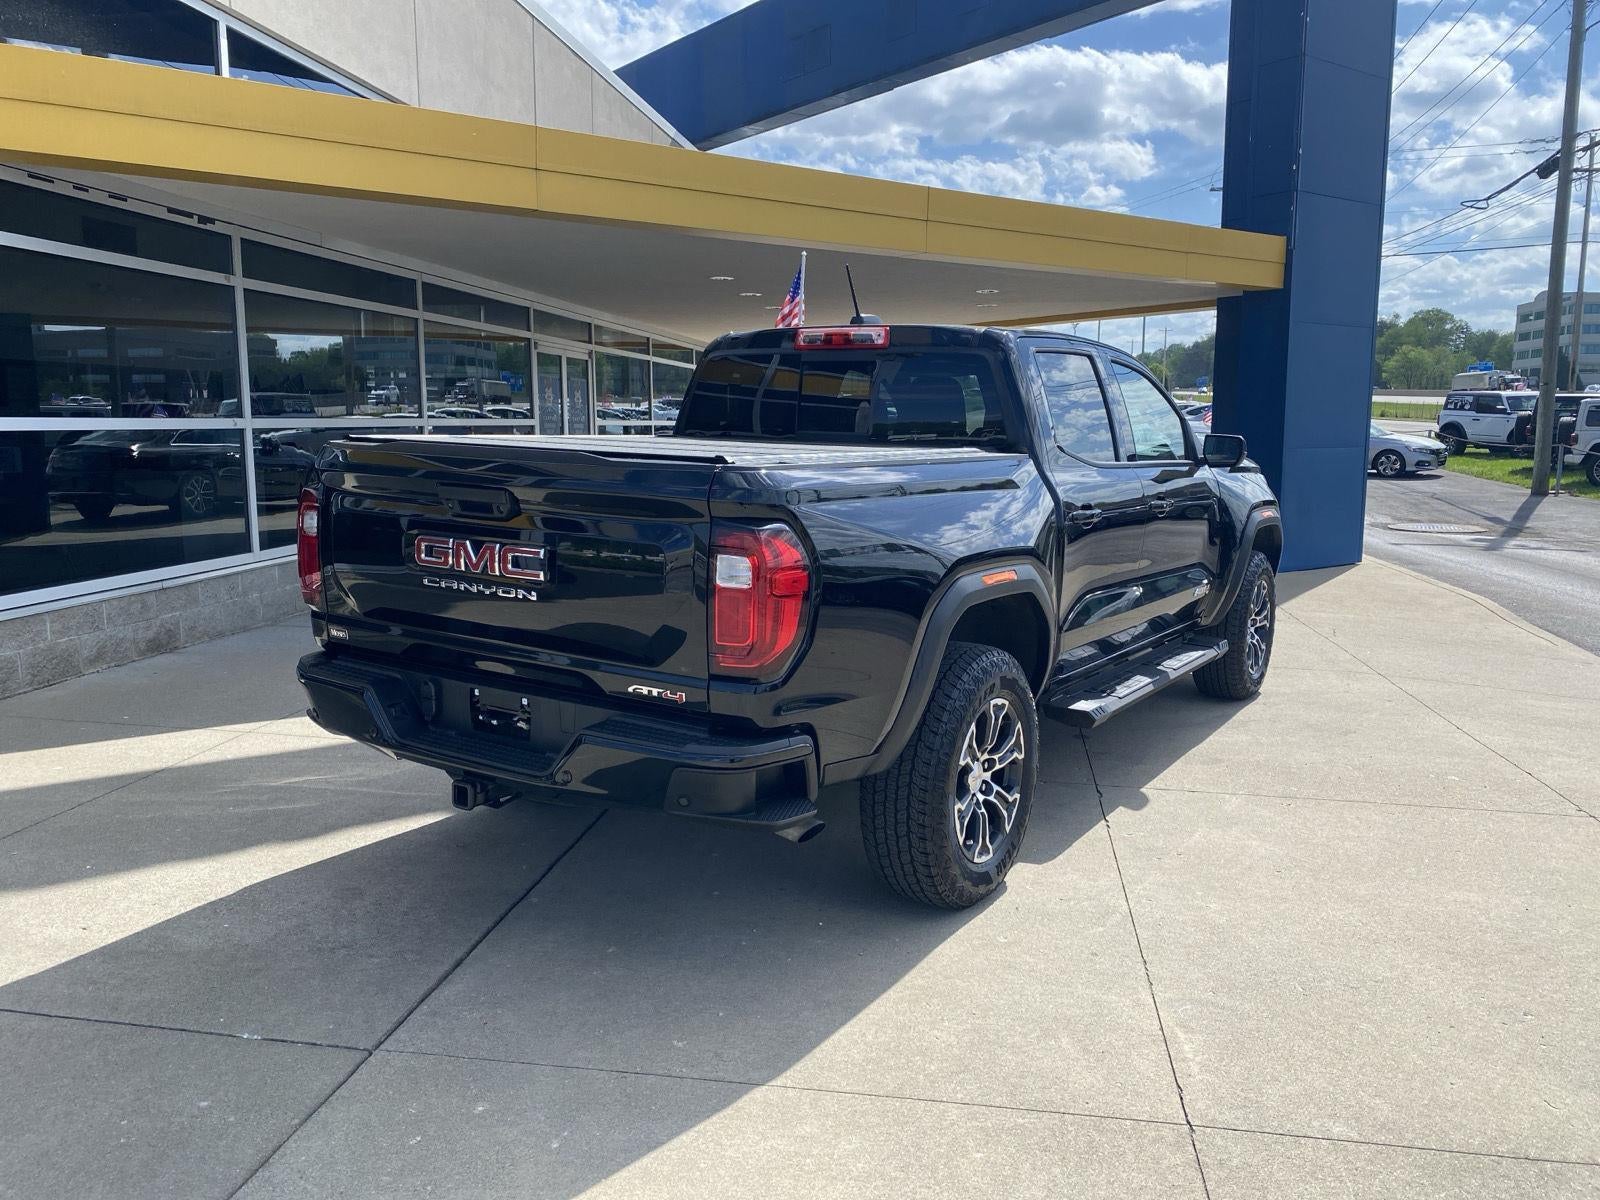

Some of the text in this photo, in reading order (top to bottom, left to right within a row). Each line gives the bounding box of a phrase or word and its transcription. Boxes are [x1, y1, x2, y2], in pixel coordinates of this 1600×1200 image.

[414, 535, 545, 581] GMC
[422, 576, 537, 601] CANYON
[627, 685, 686, 704] AT4
